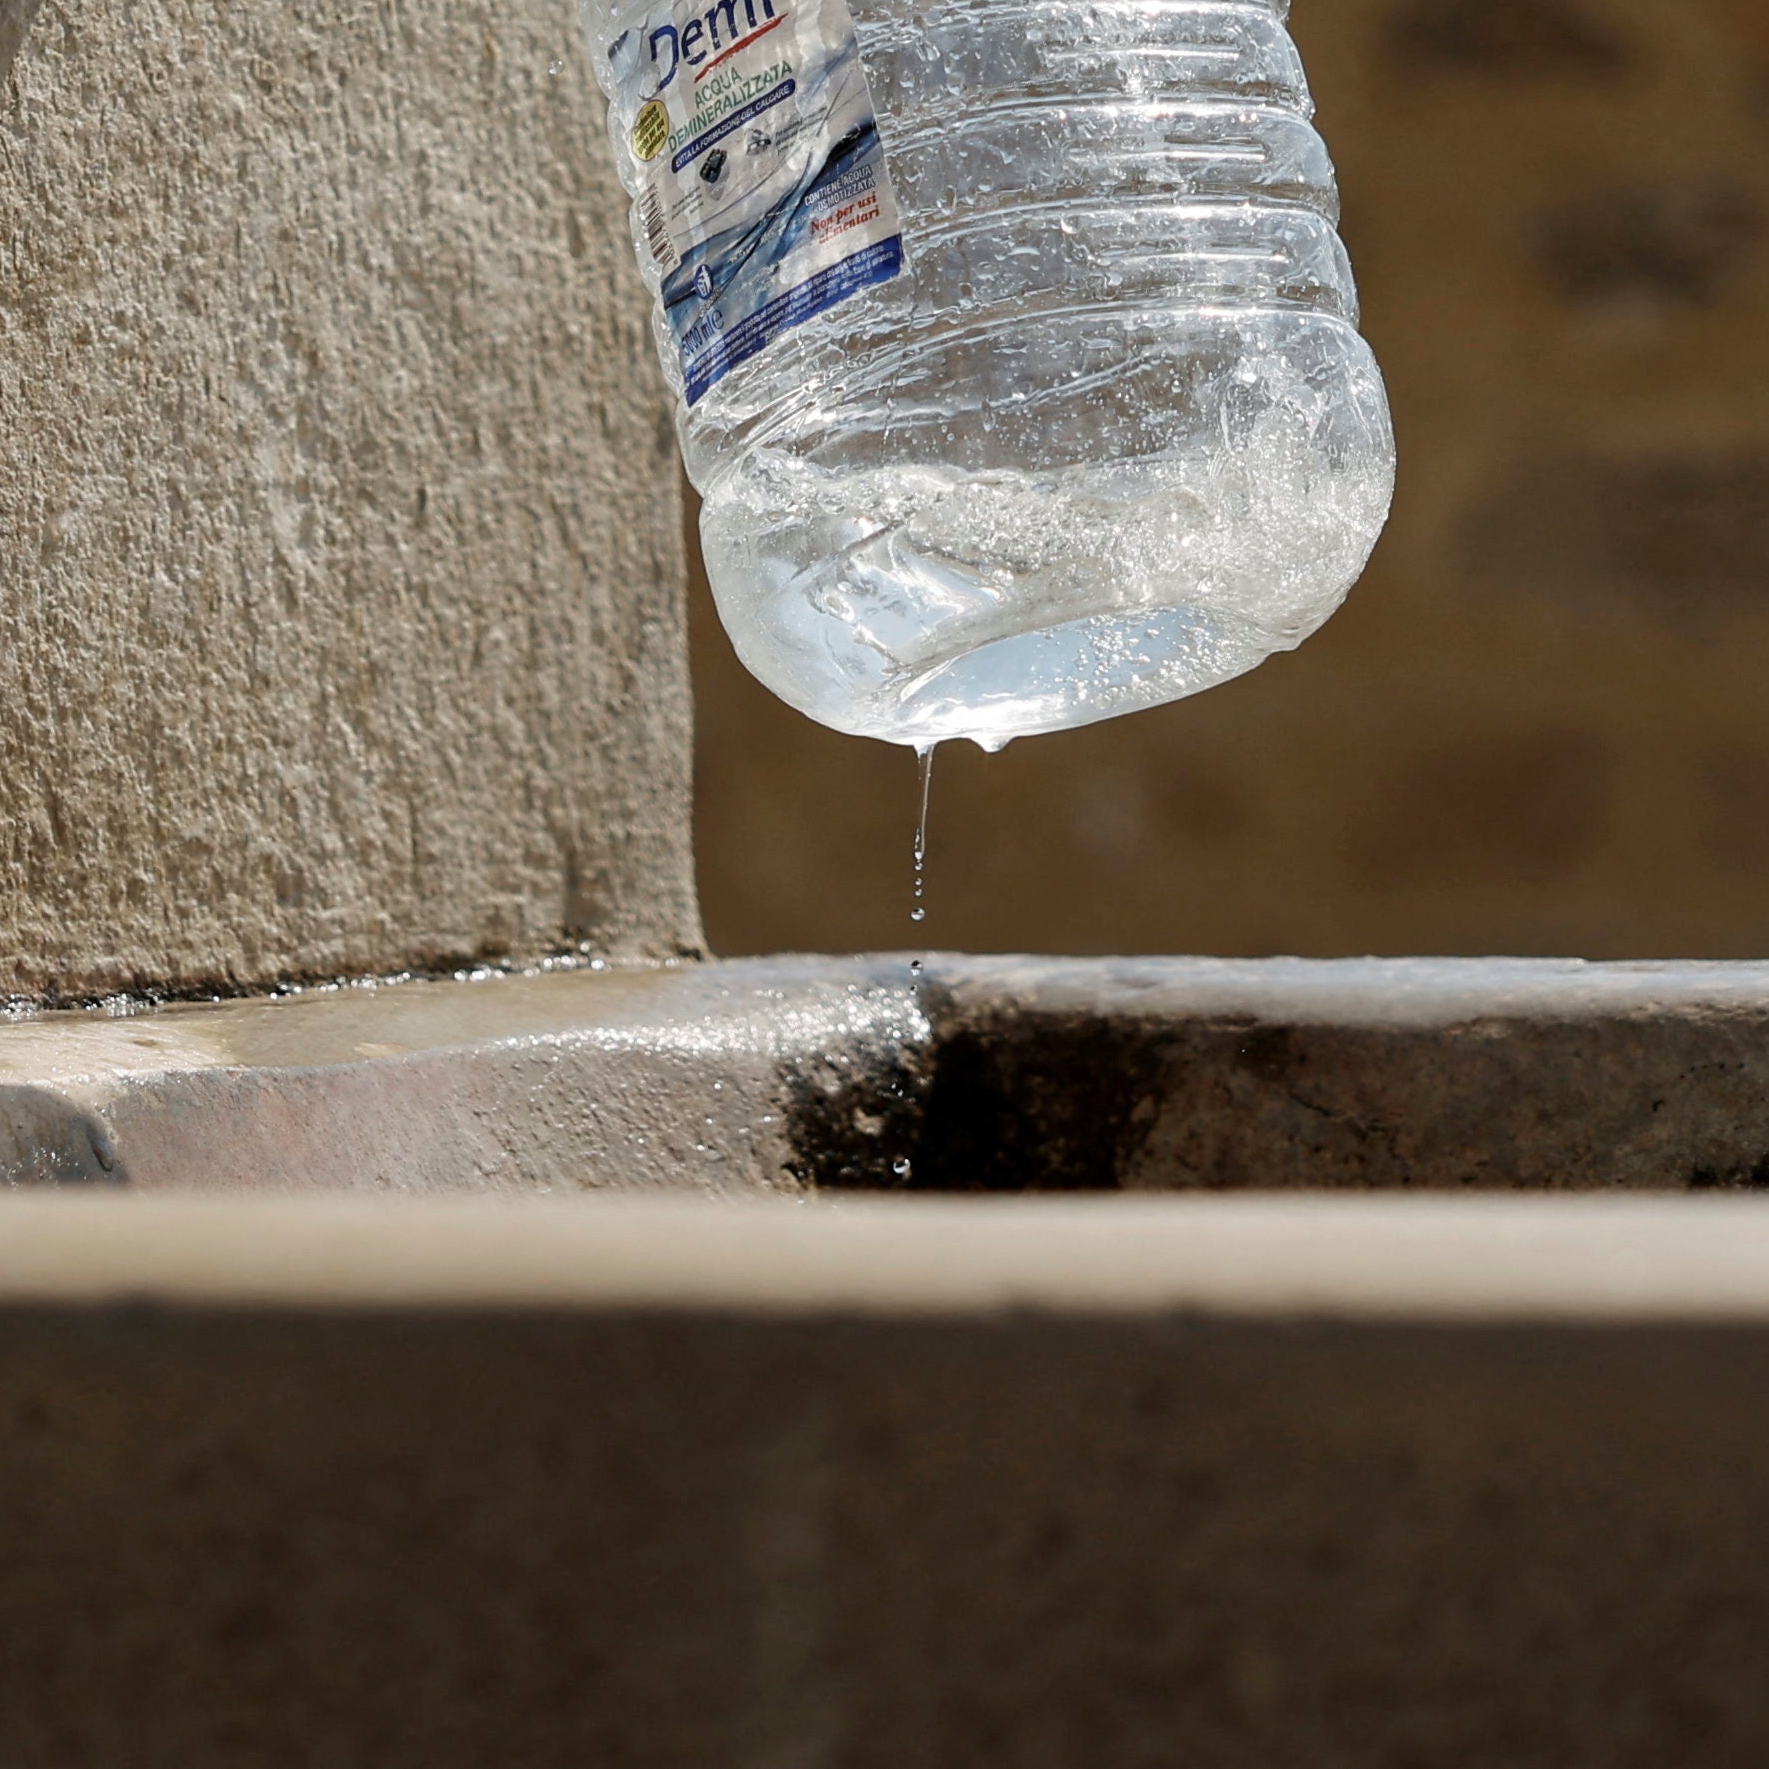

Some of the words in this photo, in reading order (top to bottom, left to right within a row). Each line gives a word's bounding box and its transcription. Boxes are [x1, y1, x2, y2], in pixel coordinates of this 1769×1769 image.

[668, 60, 793, 153] DEMINERALIZZATA
[695, 67, 742, 109] ACQUA
[675, 150, 692, 167] EVITA
[700, 116, 741, 148] FORMAZIONE
[740, 108, 755, 120] DEL
[755, 84, 791, 111] CALCARE
[804, 179, 843, 206] CONTIENE
[842, 165, 872, 185] ACQUA
[817, 177, 876, 211] OSMOTIZZATA
[810, 216, 833, 234] Non
[836, 204, 854, 224] per
[858, 191, 877, 208] usi
[819, 204, 880, 244] alimentari
